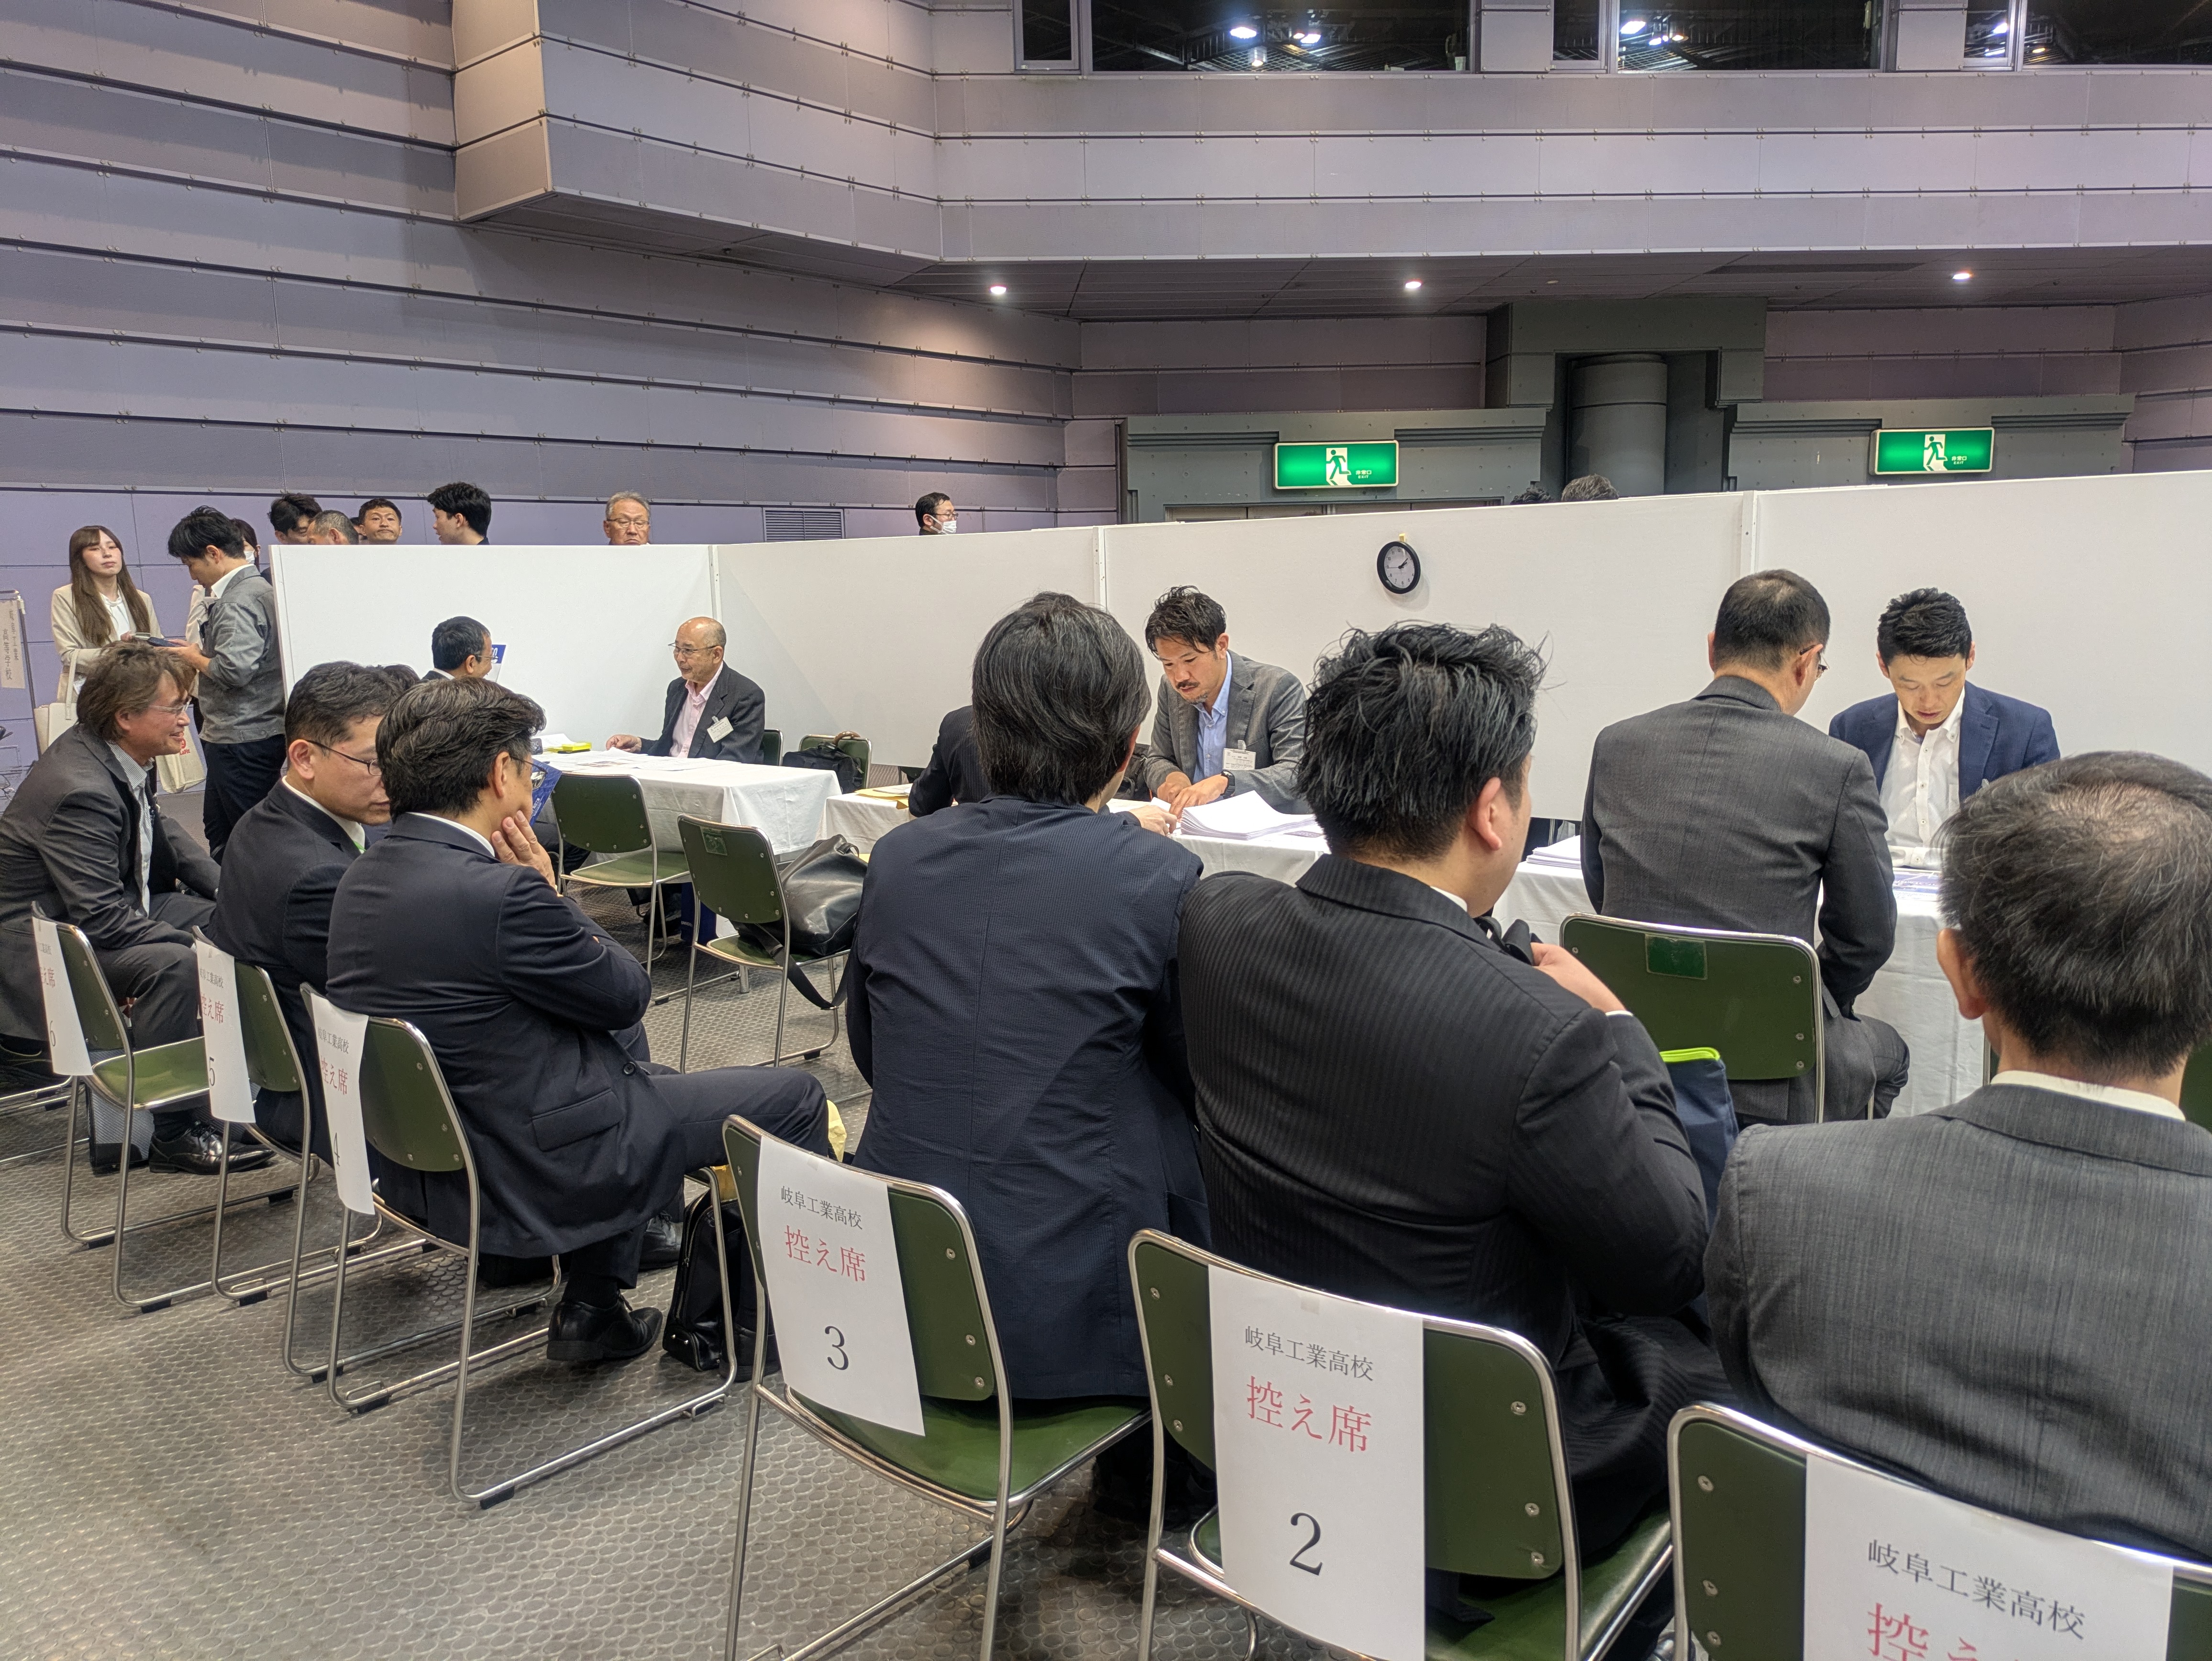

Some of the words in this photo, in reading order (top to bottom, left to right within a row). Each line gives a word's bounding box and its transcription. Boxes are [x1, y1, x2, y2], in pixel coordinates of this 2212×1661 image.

[50, 1020, 56, 1047] 6
[318, 1026, 349, 1054] 岐阜工業高校
[209, 1056, 215, 1086] 5
[334, 1132, 340, 1166] 4
[781, 1185, 862, 1229] 岐阜工業高校
[785, 1225, 865, 1282] 控え席
[825, 1326, 849, 1371] 3
[1245, 1326, 1373, 1381] 岐阜工業高校
[1247, 1376, 1371, 1452] 控え席
[1290, 1512, 1323, 1576] 2
[1868, 1539, 2085, 1640] 岐阜工業高校
